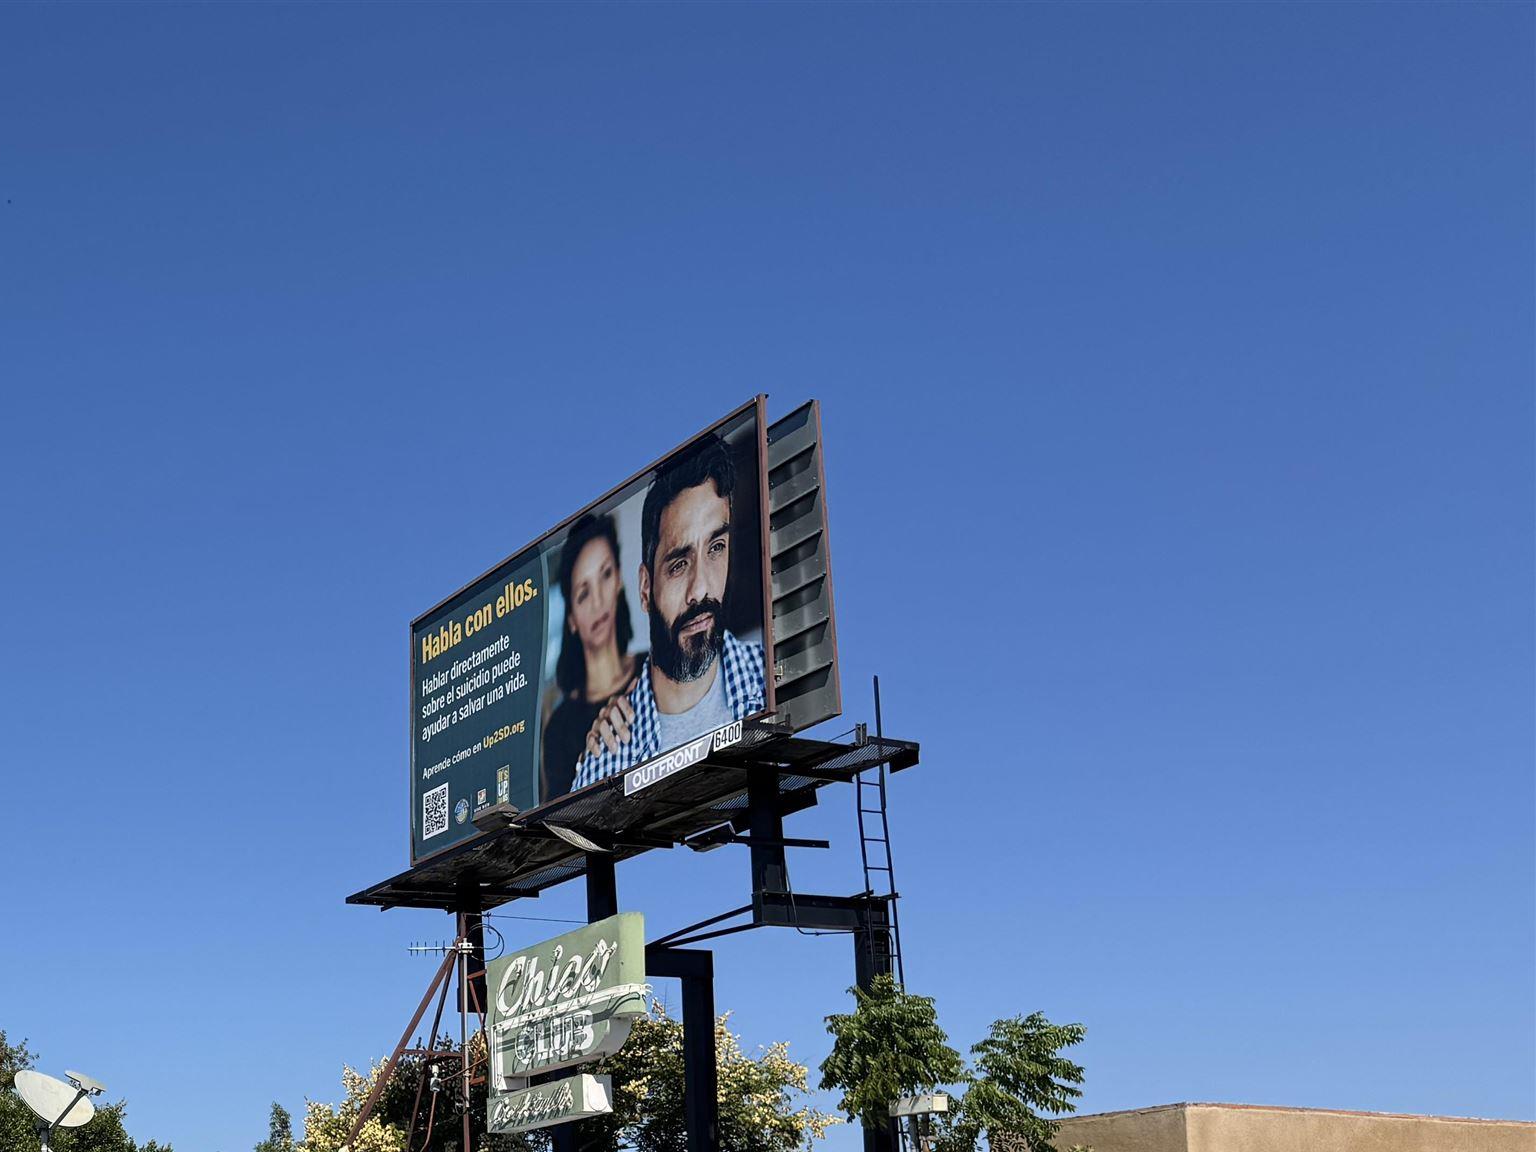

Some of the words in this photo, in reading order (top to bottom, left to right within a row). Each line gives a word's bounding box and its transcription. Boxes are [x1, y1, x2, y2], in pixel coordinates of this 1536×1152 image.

[422, 620, 462, 664] Habla
[465, 603, 492, 637] con
[496, 578, 538, 618] ellos.
[422, 670, 449, 697] Hablar
[451, 635, 510, 680] directamente
[422, 696, 445, 719] sobre
[447, 685, 454, 705] el
[456, 668, 490, 699] suicidio
[492, 651, 521, 684] puede
[422, 714, 451, 742] ayudar
[452, 711, 457, 724] a
[459, 698, 485, 720] salvar
[487, 685, 504, 706] una
[506, 672, 528, 695] vida.
[422, 758, 451, 780] Aprende
[452, 747, 472, 765] cómo
[473, 742, 482, 754] en
[483, 720, 525, 748] Up2SD.org
[632, 741, 704, 788] OUTFRONT
[715, 722, 741, 748] 6400
[496, 939, 617, 1017] Chico
[515, 1010, 594, 1065] CLUB
